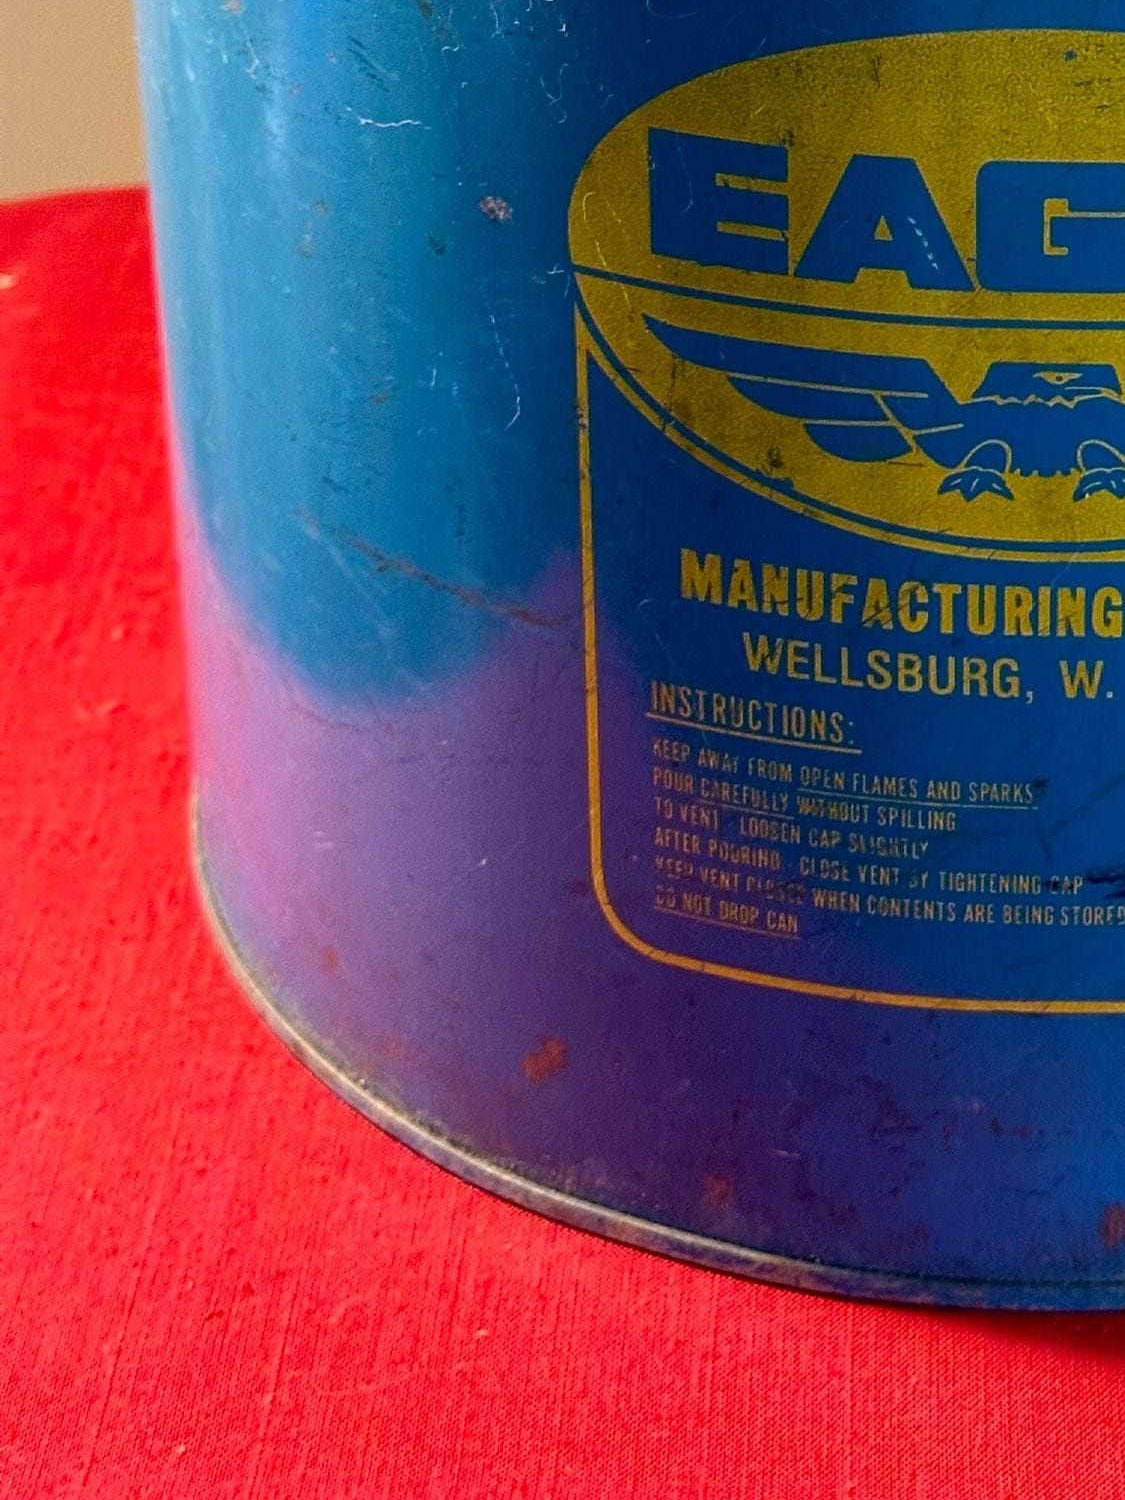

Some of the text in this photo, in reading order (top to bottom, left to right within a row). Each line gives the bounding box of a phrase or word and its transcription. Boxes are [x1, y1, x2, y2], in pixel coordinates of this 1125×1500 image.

[678, 547, 1123, 637] MANUFACTURING
[742, 631, 1034, 705] WELLSBURG,
[1059, 659, 1114, 700] W.
[650, 680, 854, 745] INSTRUCTIONS:
[652, 766, 957, 832] POUR CAREFULLY WITHOUT SPILLING
[748, 757, 793, 783] FROM
[800, 765, 845, 791] OPEN
[852, 772, 919, 799] FLAMES
[926, 779, 962, 801] AND
[968, 781, 1033, 804] SPARKS
[655, 796, 673, 820] TO
[679, 803, 720, 830] VENT
[739, 816, 800, 844] LOOSEN
[808, 828, 842, 849] CAP
[654, 826, 700, 853] AFTER
[858, 864, 900, 886] VENT
[938, 870, 1041, 895] TIGHTENING
[1050, 875, 1083, 895] CAP
[682, 891, 712, 916] NOT
[719, 900, 759, 925] DROP
[766, 909, 798, 934] CAN
[700, 865, 740, 893] VENT
[812, 887, 860, 913] WHEN
[867, 894, 956, 922] CONTENTS
[963, 903, 995, 924] ARE
[1003, 904, 1054, 925] BEING
